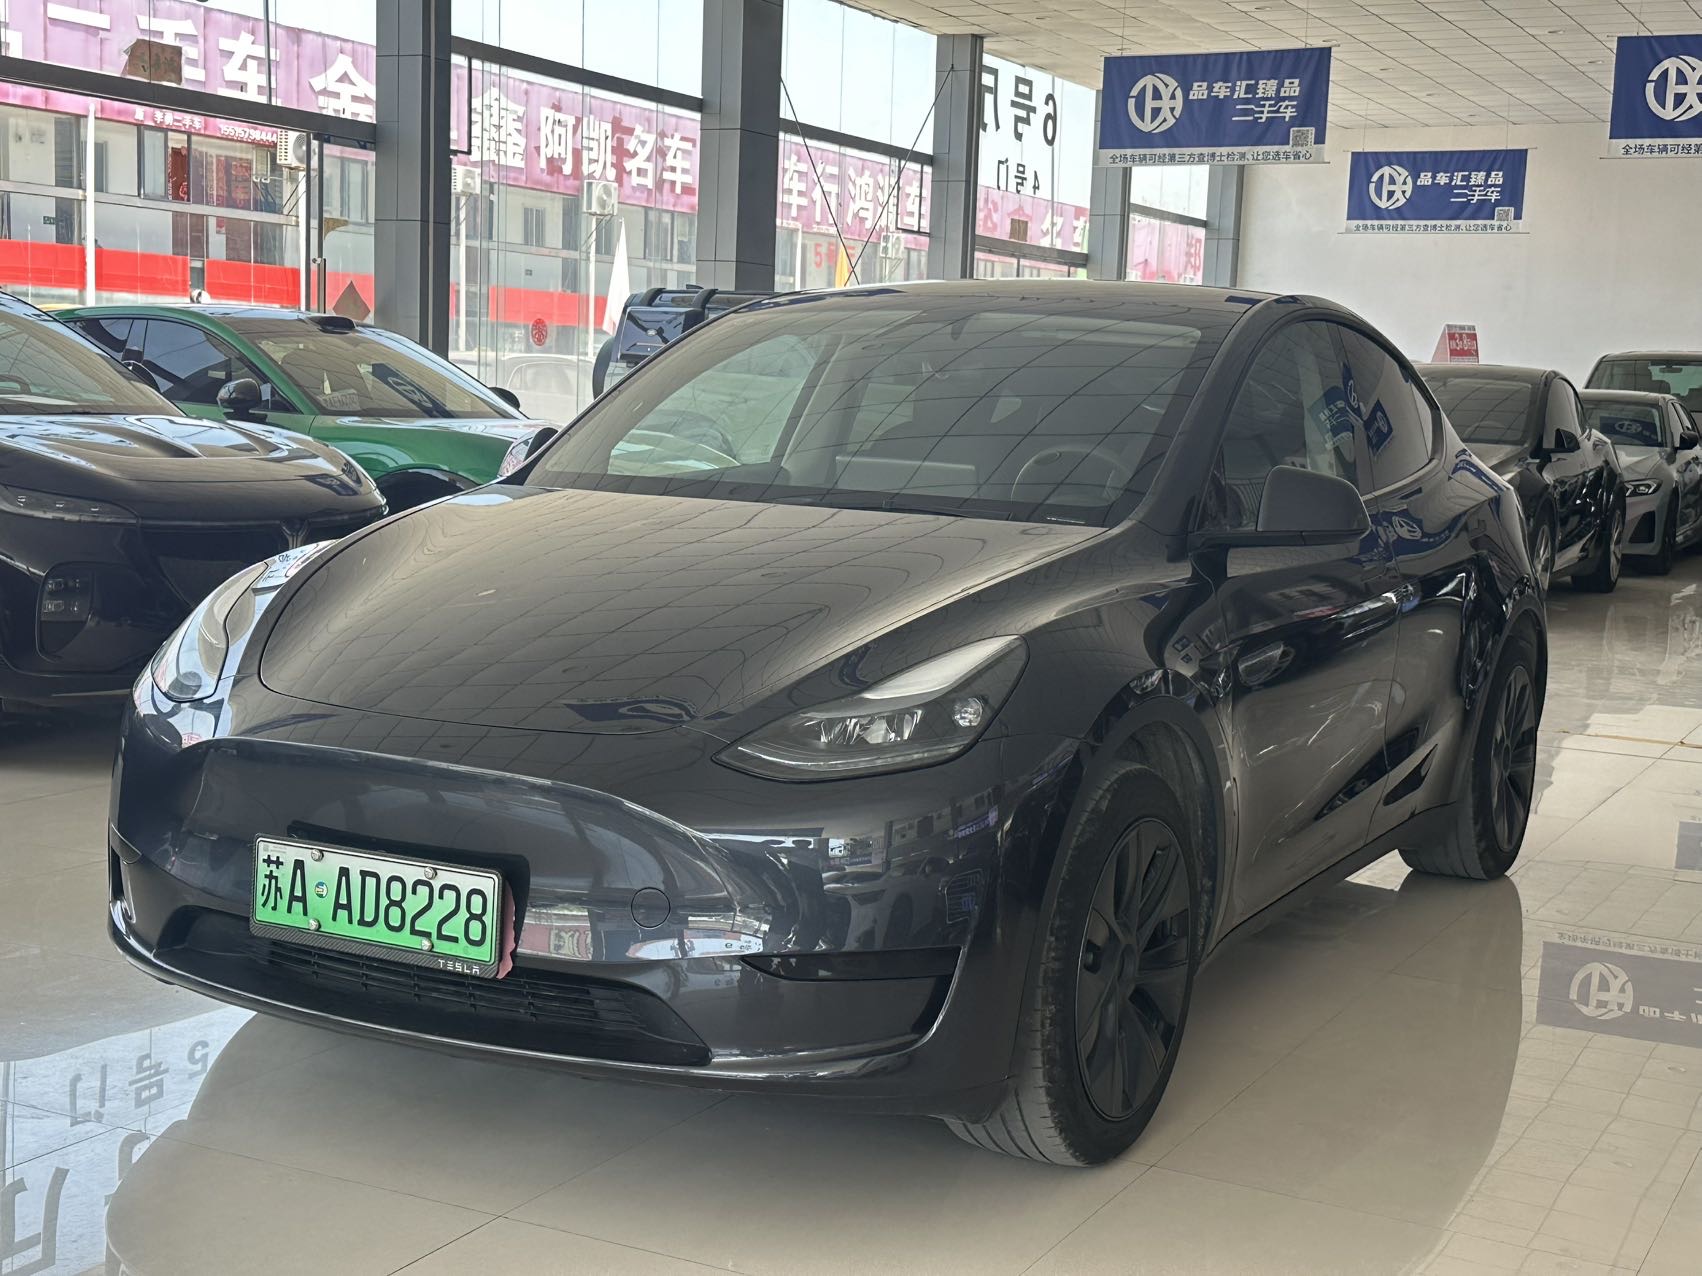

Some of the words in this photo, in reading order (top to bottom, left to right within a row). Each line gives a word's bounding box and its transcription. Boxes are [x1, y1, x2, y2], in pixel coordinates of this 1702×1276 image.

[1188, 79, 1300, 100] 品车汇臻品
[1232, 100, 1298, 123] 二手车
[1450, 186, 1501, 203] 二手车
[261, 854, 308, 916] 苏A
[332, 866, 488, 947] AD8228
[438, 959, 480, 975] TESLA
